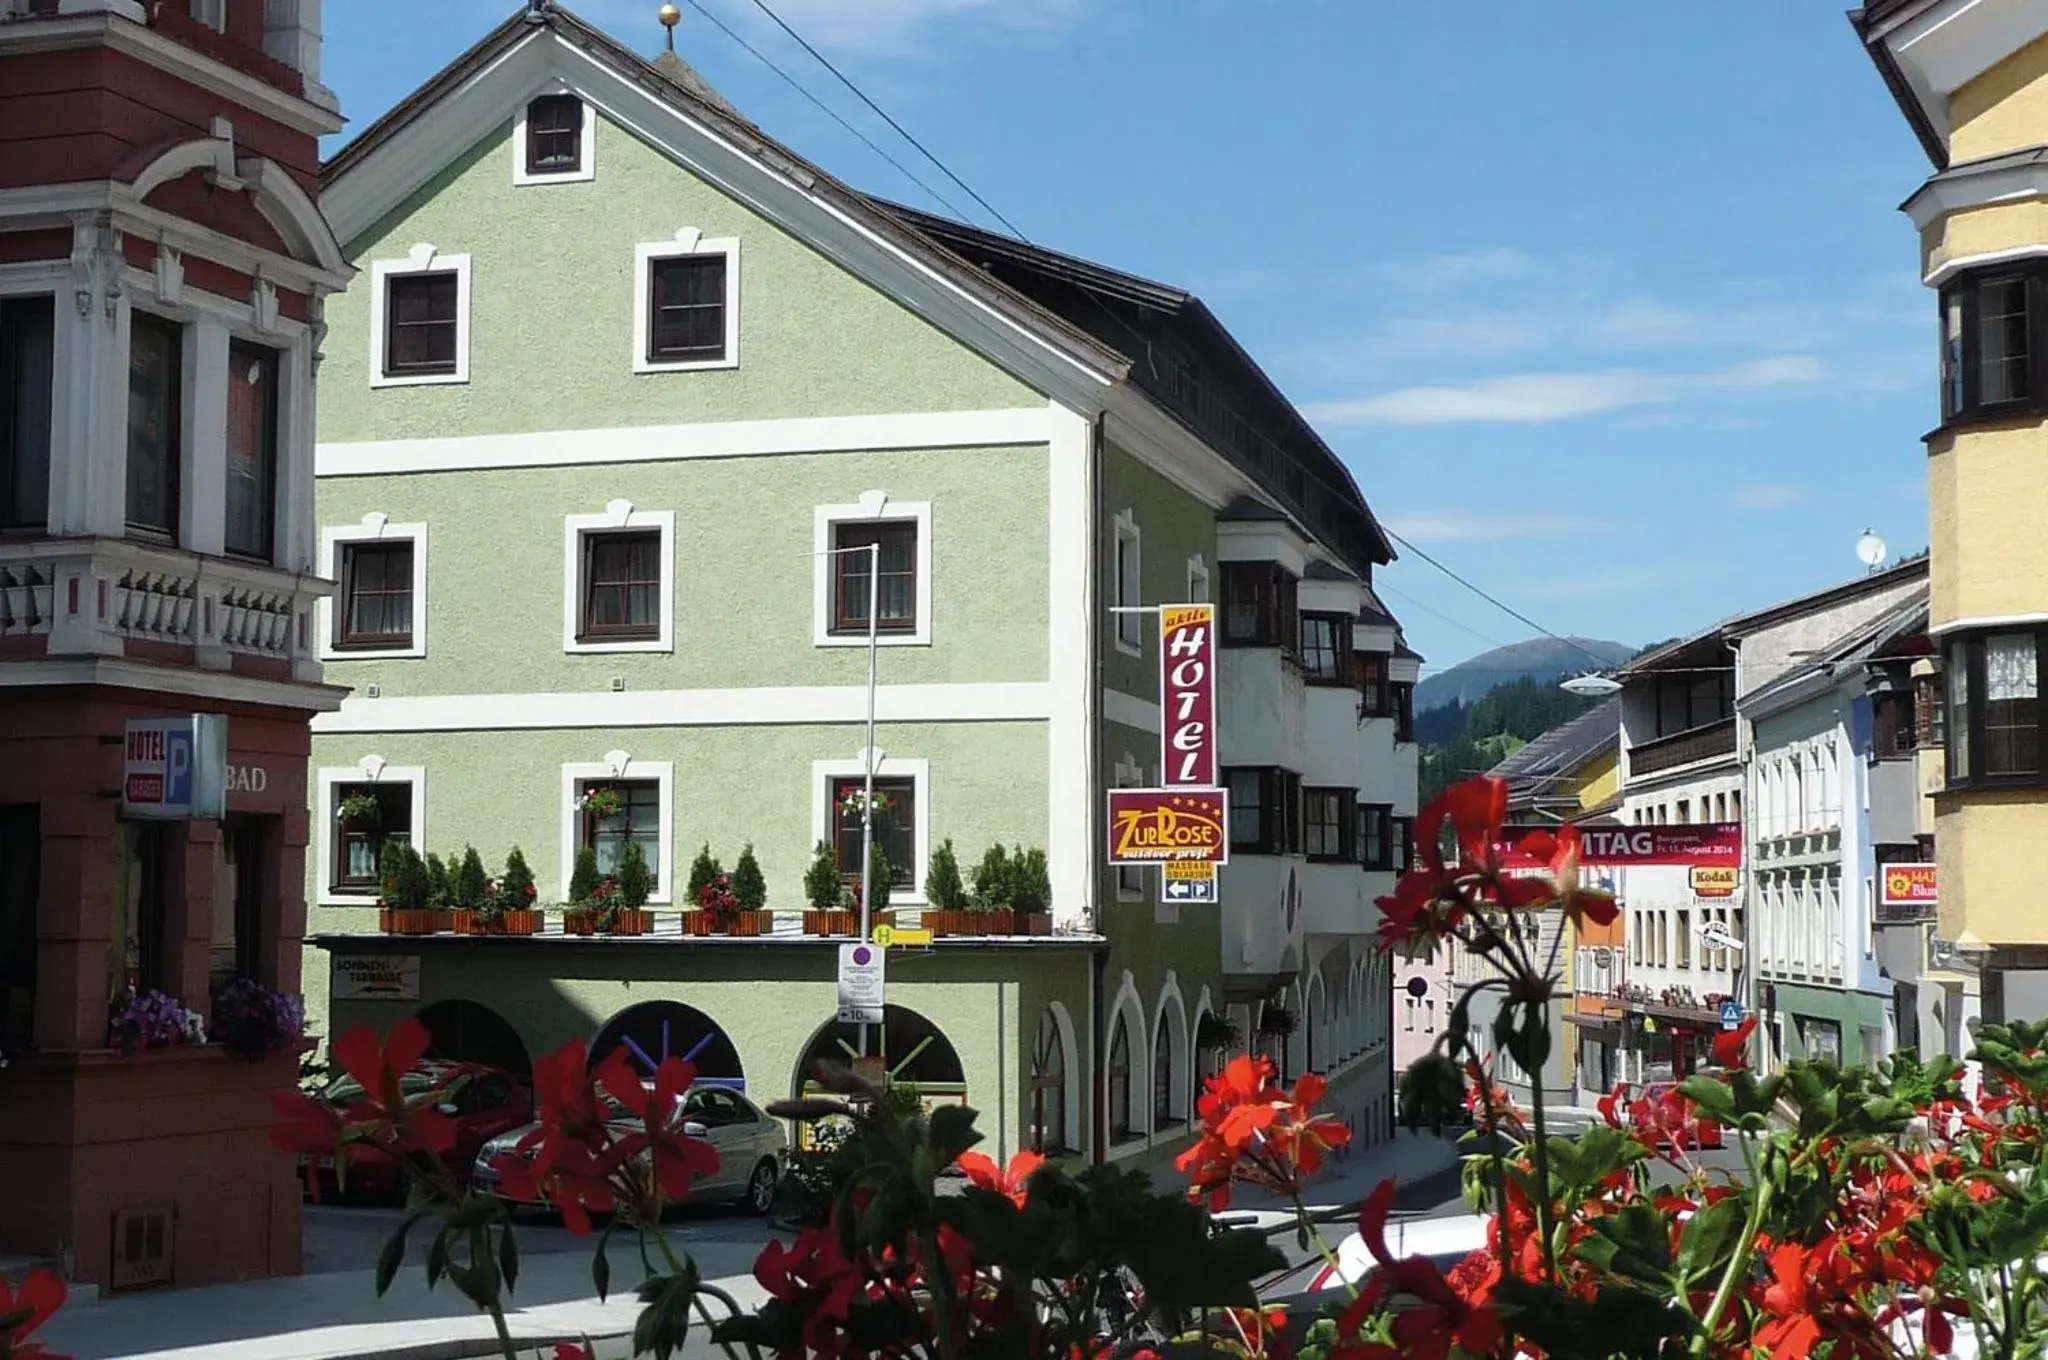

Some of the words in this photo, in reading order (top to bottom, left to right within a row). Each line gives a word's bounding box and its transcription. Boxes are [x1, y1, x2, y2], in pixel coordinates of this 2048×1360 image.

[128, 730, 165, 761] HOTEL
[169, 738, 189, 798] P
[225, 765, 267, 791] BAD
[1695, 871, 1733, 882] Kodak
[877, 928, 890, 944] H
[851, 1010, 864, 1021] 10
